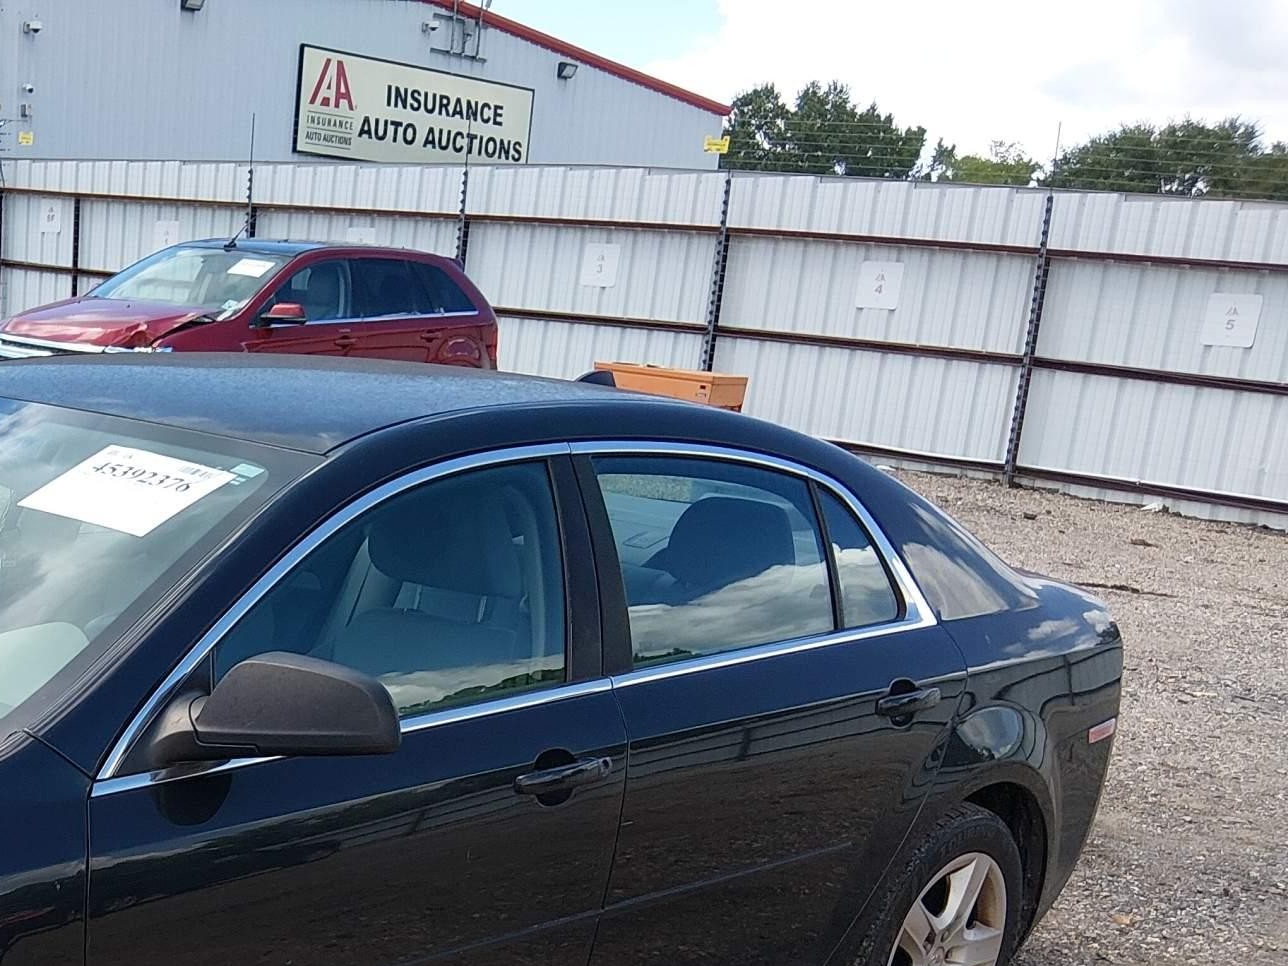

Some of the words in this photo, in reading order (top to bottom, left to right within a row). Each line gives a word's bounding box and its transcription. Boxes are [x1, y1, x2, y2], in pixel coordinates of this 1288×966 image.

[386, 84, 504, 127] INSURANCE
[306, 114, 354, 131] INSURANCE
[305, 130, 322, 142] AUTO
[322, 133, 352, 146] AUCTIONS
[357, 115, 417, 146] AUTO
[422, 126, 523, 163] AUCTIONS
[1225, 319, 1236, 330] 5
[92, 462, 191, 492] 45392376
